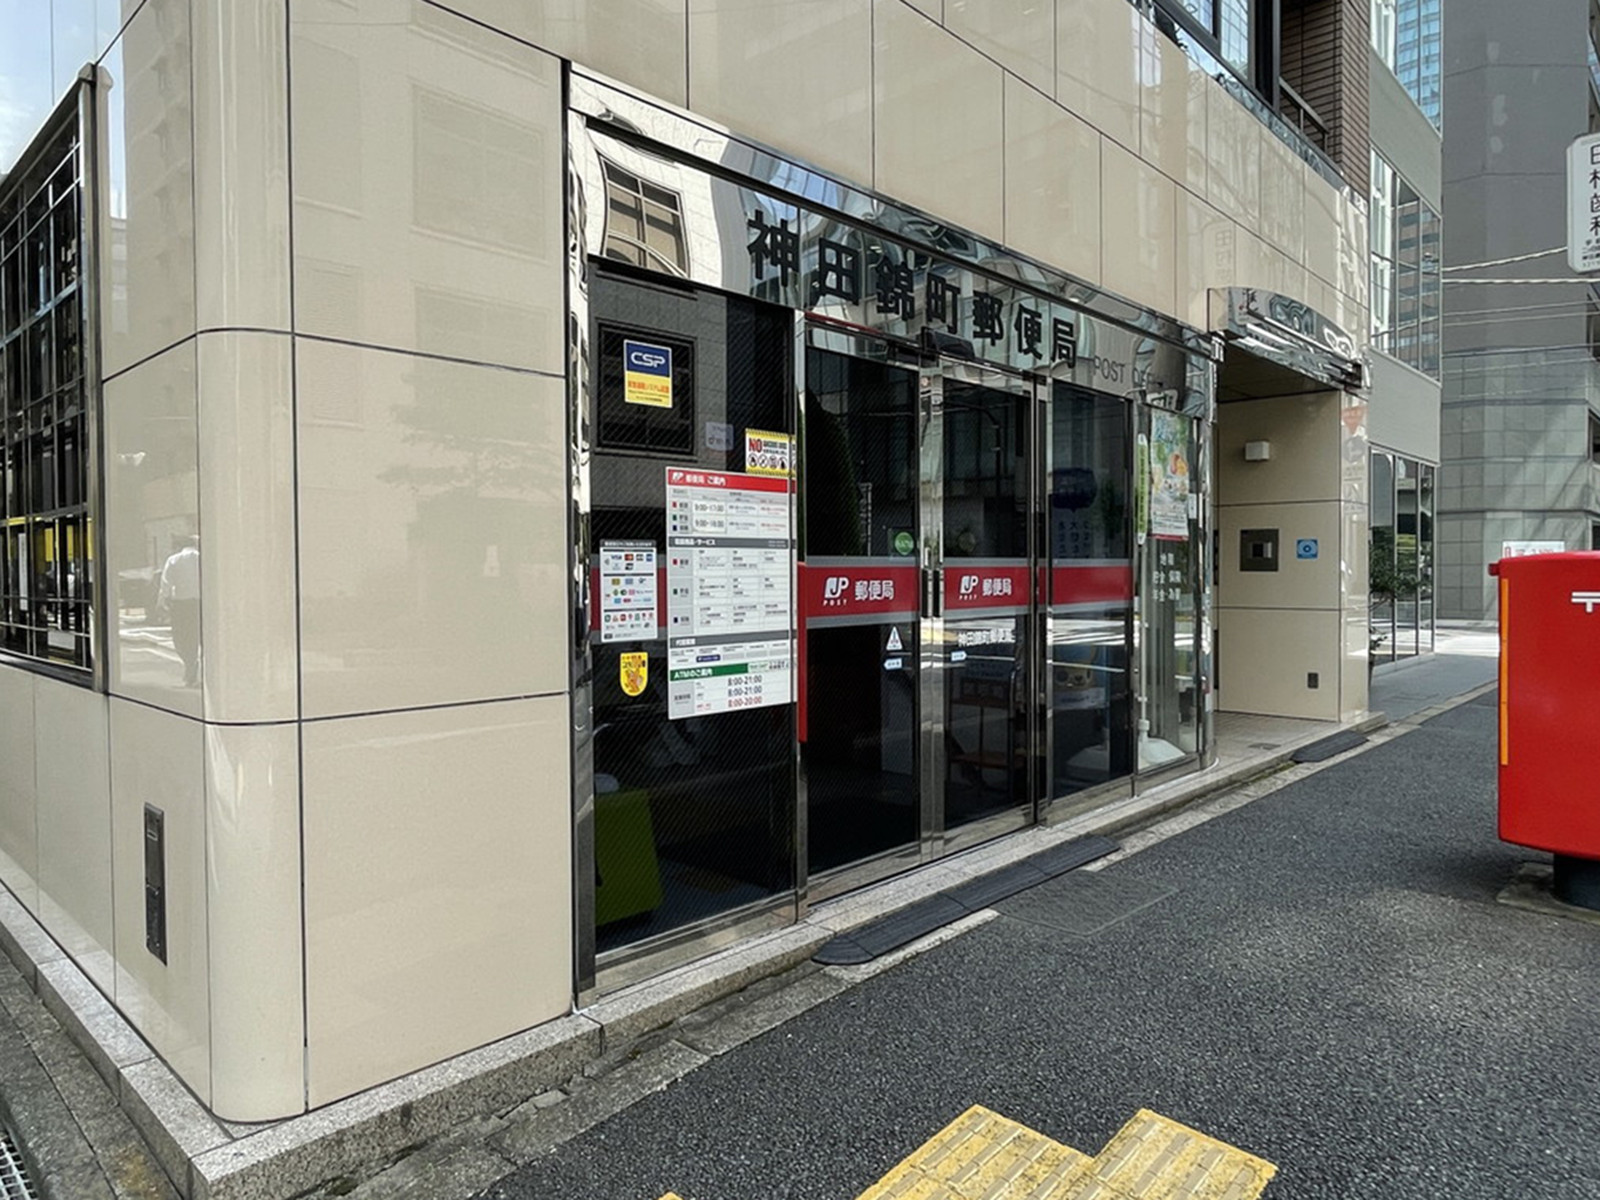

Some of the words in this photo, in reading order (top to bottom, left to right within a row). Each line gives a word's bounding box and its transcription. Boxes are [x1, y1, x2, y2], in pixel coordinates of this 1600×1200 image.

[747, 209, 1076, 368] 神田錦町郵便局
[630, 351, 665, 368] CSP
[1093, 355, 1125, 384] POST
[748, 437, 763, 453] NO
[854, 580, 894, 601] 郵便局
[982, 578, 1012, 597] 郵便局
